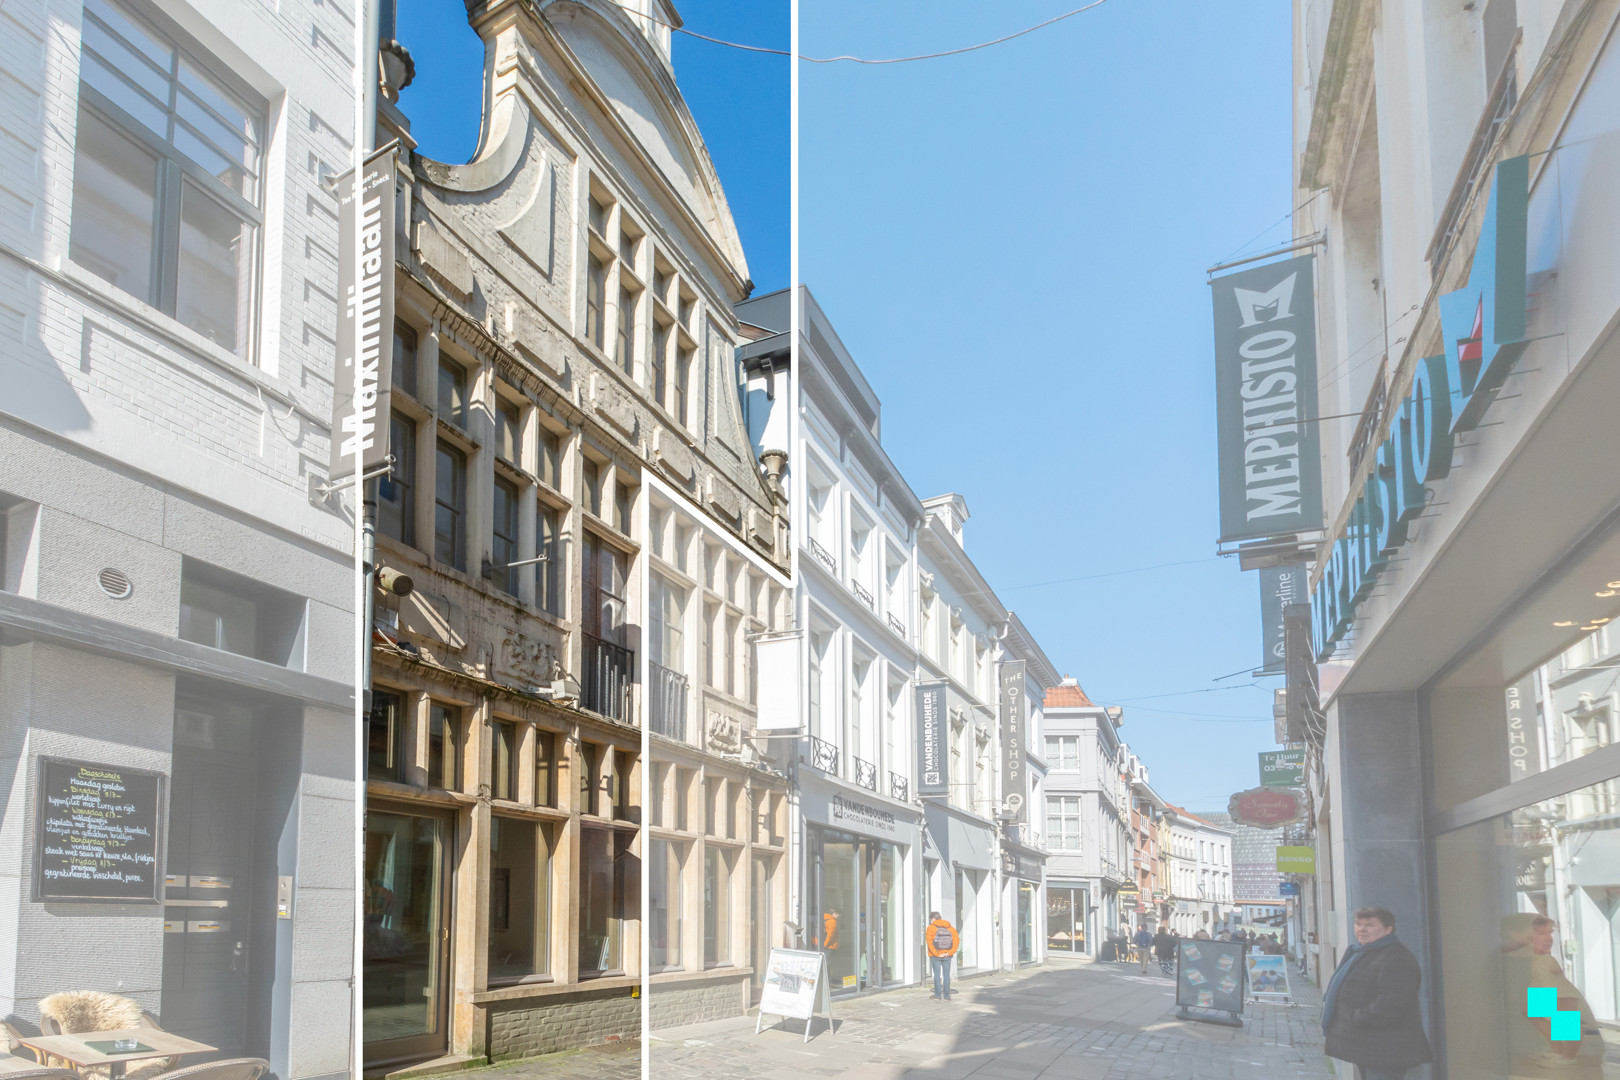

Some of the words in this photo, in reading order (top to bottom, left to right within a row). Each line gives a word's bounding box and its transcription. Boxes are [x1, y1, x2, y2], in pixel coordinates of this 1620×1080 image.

[372, 173, 390, 188] Snack
[340, 196, 382, 457] Maximiliaan
[1239, 330, 1302, 523] MEPHISTO
[1311, 355, 1452, 663] MEPHISTO
[1005, 672, 1022, 684] THE
[1008, 687, 1018, 733] OTHER
[923, 692, 933, 771] VANDENBOUHEDE
[1008, 739, 1019, 780] SHOP
[1263, 754, 1276, 762] Te
[80, 768, 121, 780] Dagschotels
[70, 777, 101, 791] Maandag
[102, 783, 126, 792] gesloten
[843, 797, 896, 825] VANDENBOUHEDE
[843, 811, 875, 828] CHOCOLATERIE
[45, 846, 64, 855] steak
[1278, 855, 1313, 864] BONGO
